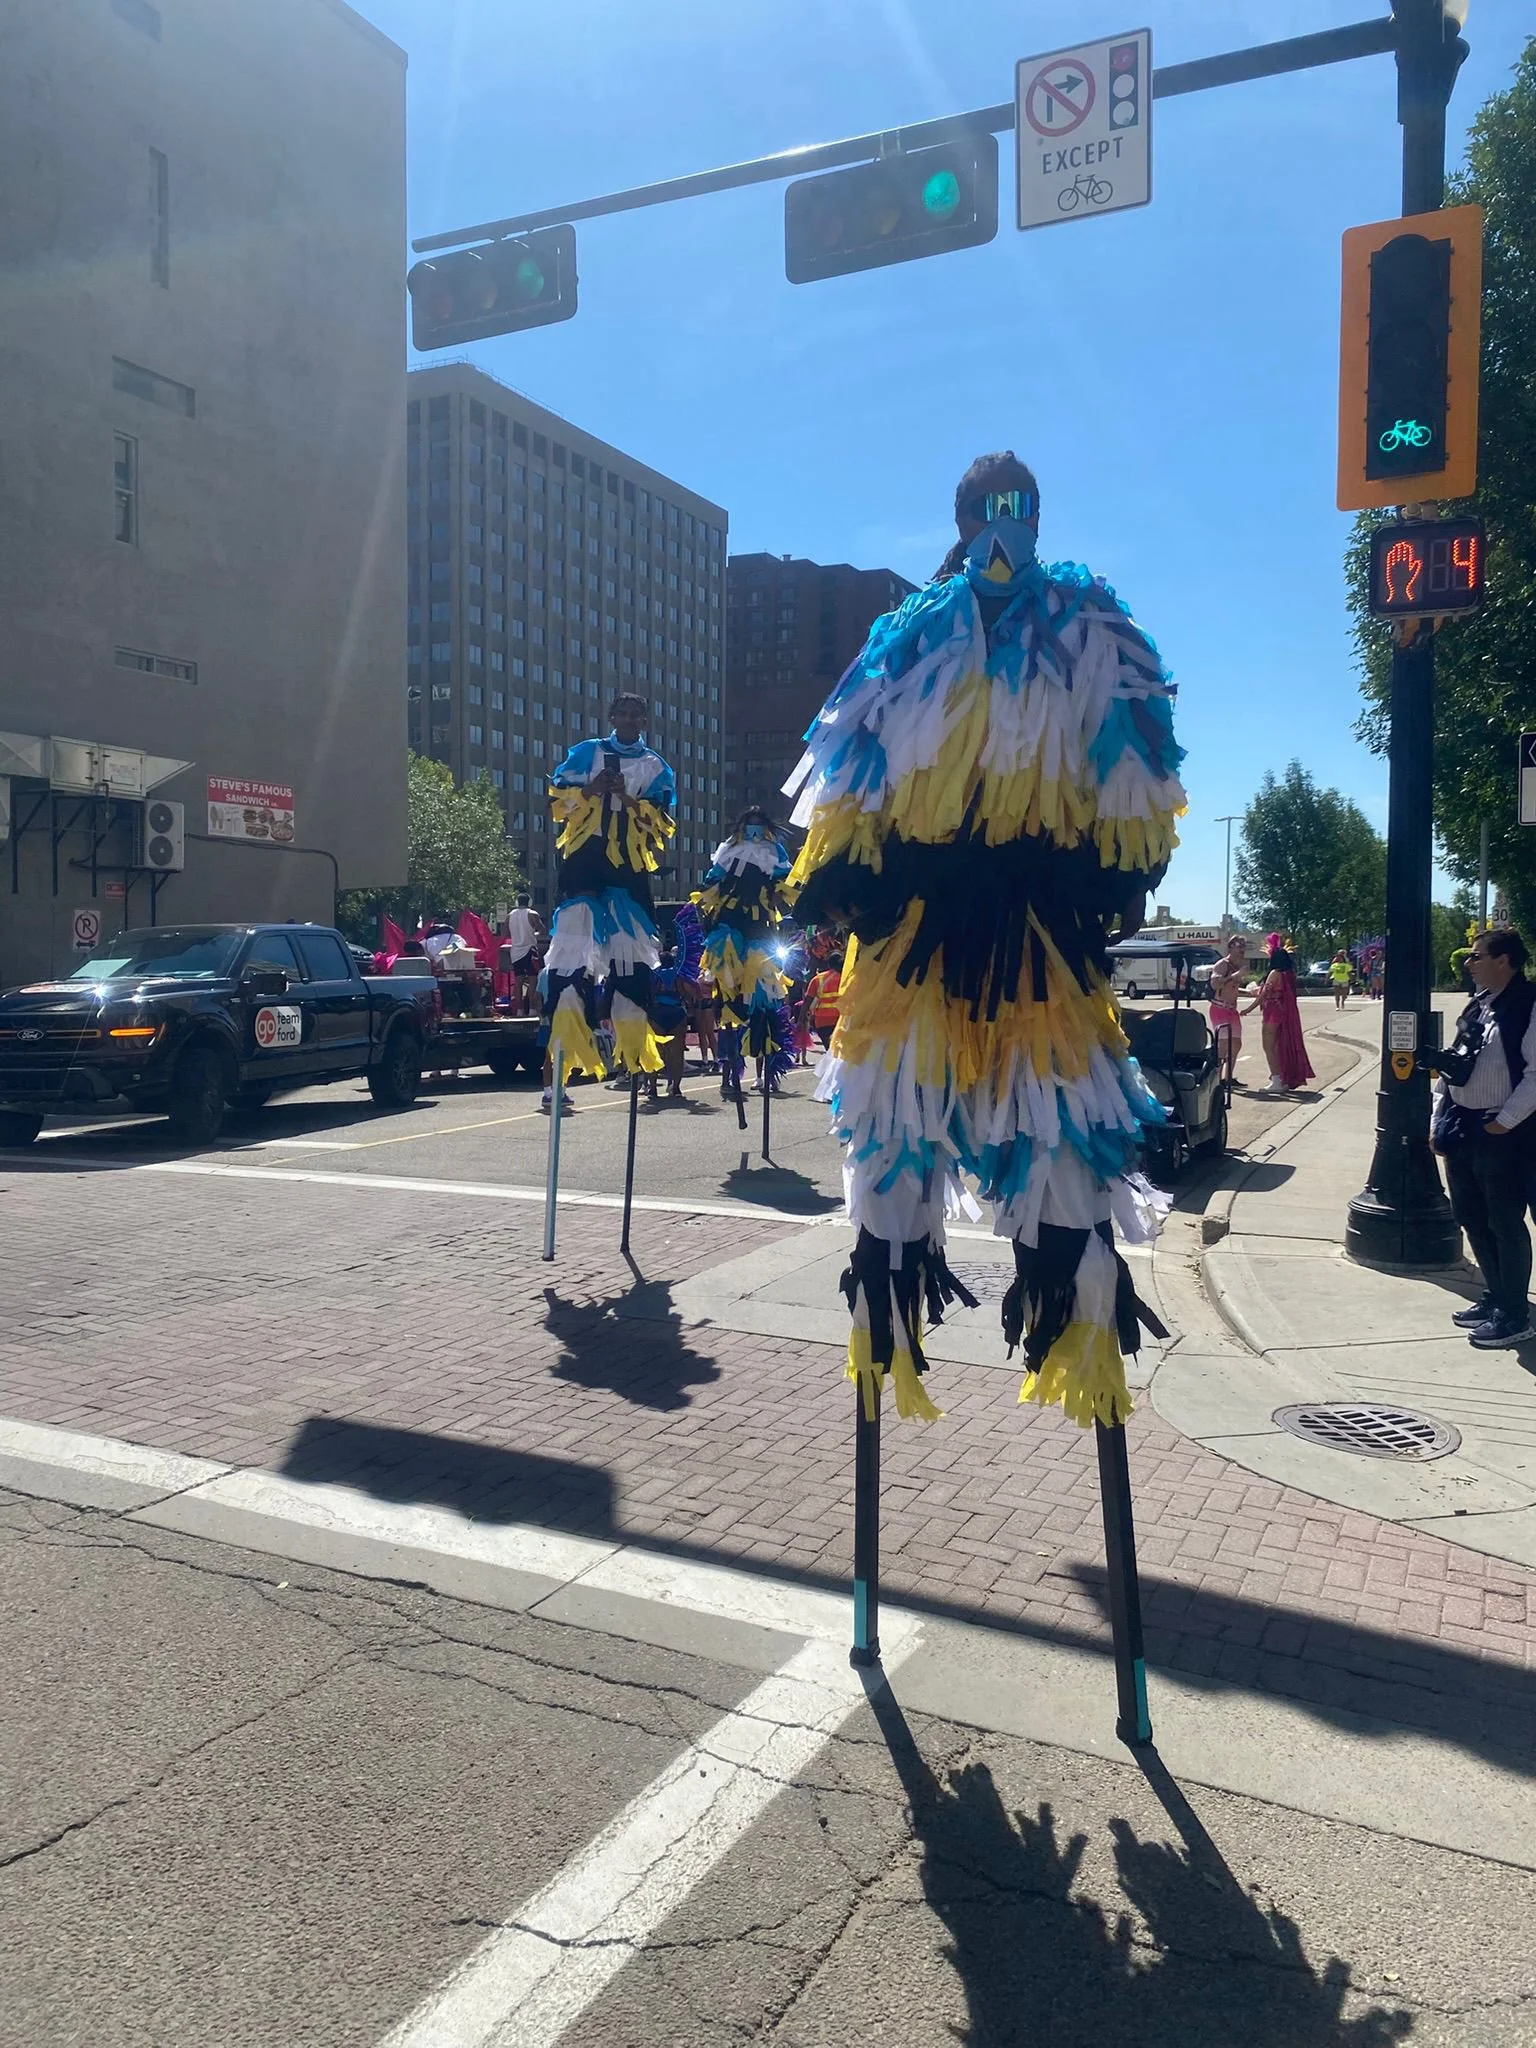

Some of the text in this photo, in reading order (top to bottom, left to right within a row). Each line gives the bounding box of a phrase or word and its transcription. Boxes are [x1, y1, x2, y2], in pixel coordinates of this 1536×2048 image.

[1042, 136, 1124, 175] EXCEPT
[1452, 536, 1478, 589] 4
[209, 778, 293, 798] STEVE'S FAMOUS
[225, 793, 270, 807] SANDWICH
[1493, 908, 1508, 922] 30
[1177, 931, 1215, 939] U-HAUL
[277, 1011, 300, 1025] team
[258, 1019, 276, 1042] go
[277, 1026, 296, 1041] ford
